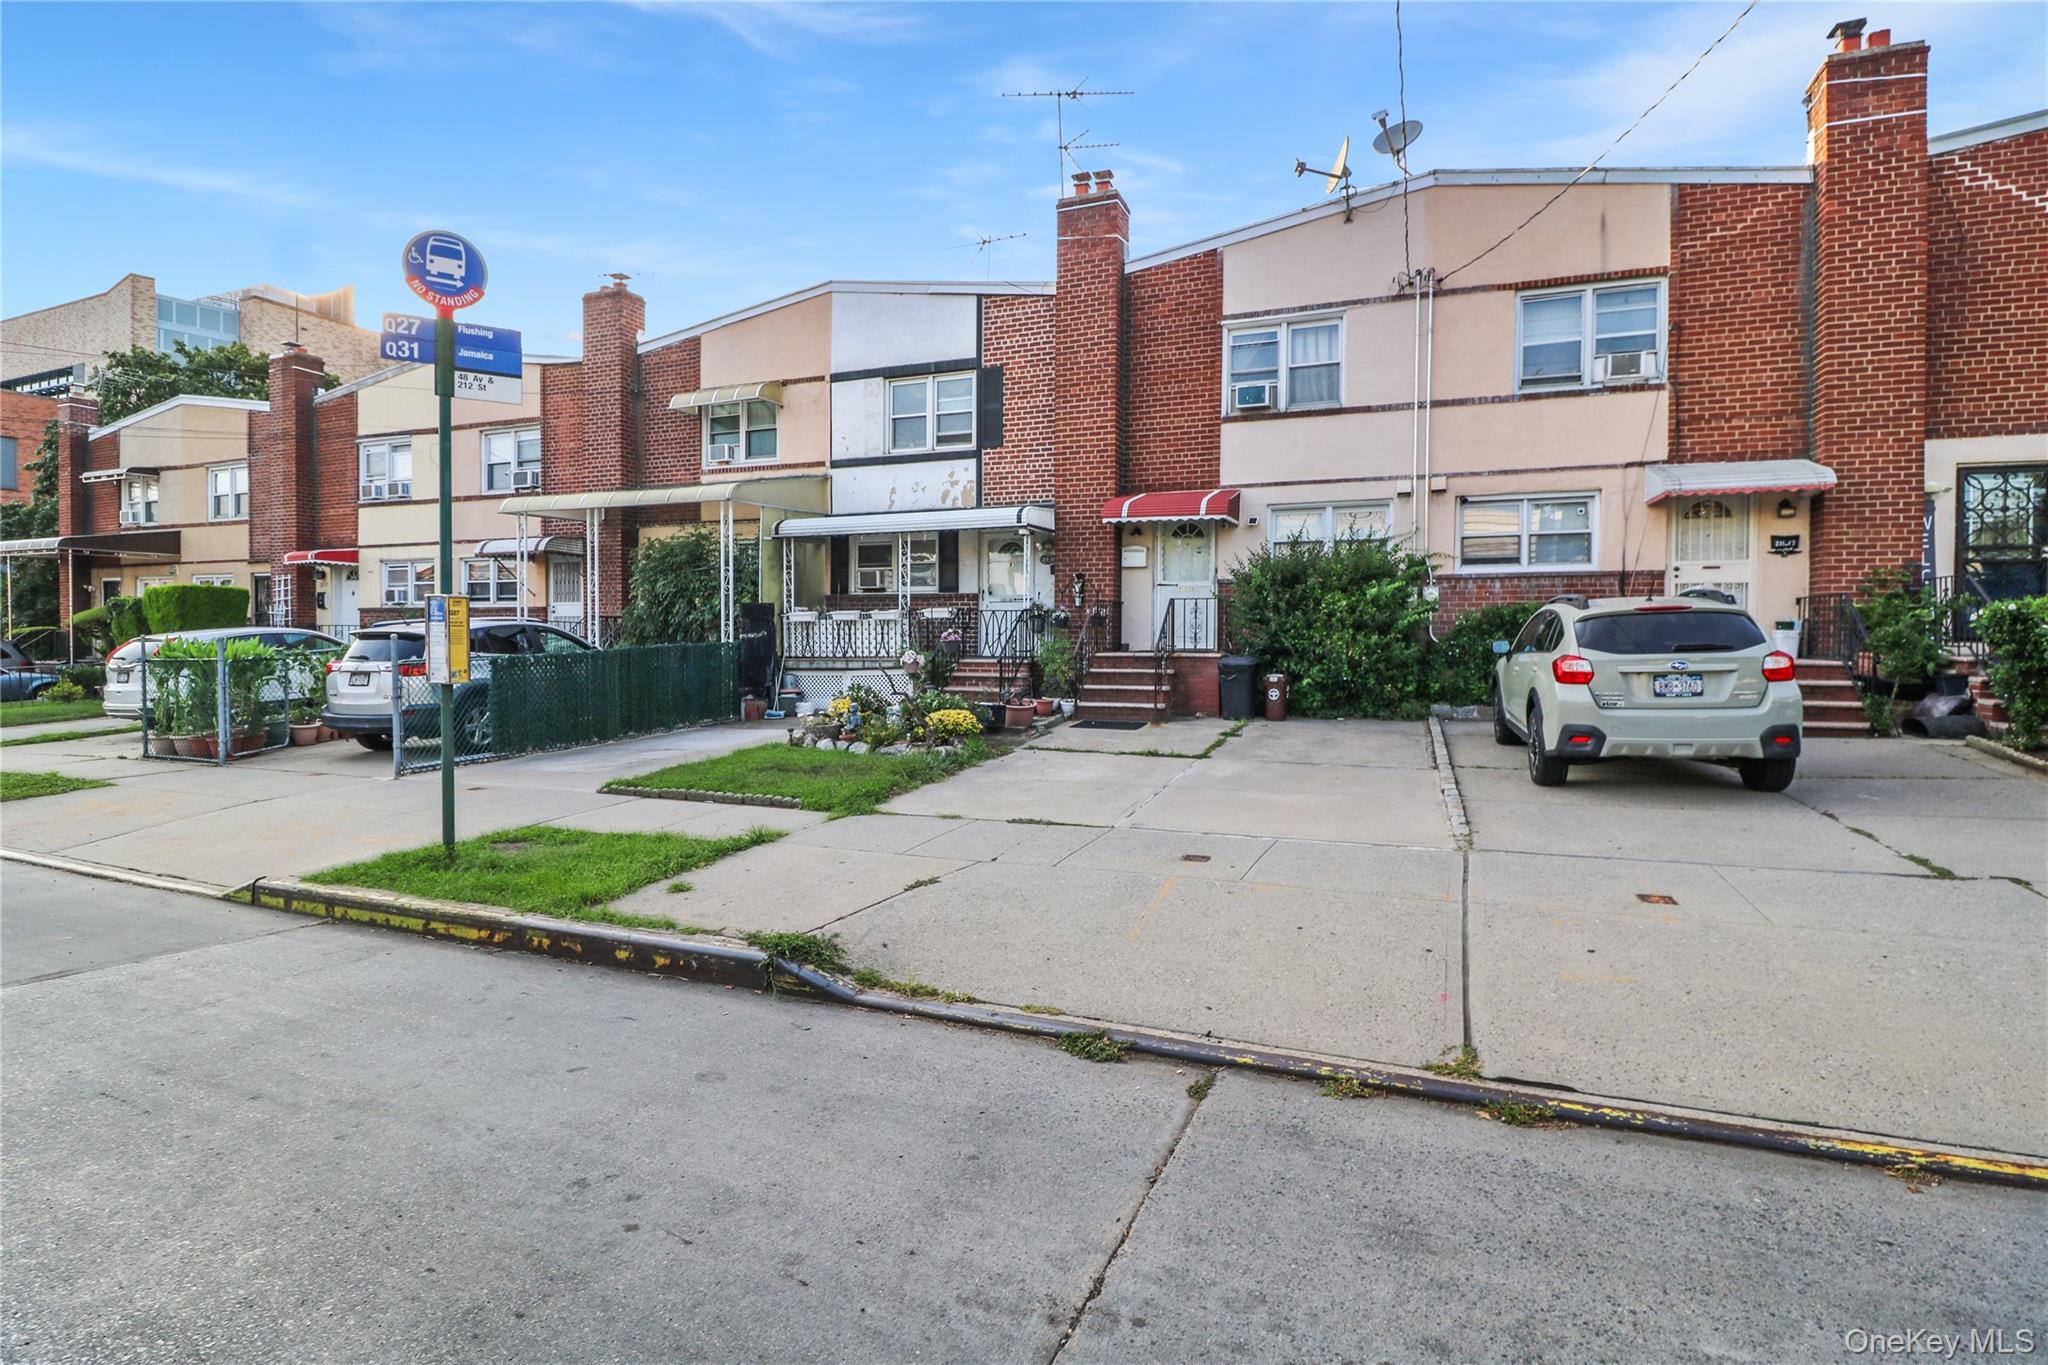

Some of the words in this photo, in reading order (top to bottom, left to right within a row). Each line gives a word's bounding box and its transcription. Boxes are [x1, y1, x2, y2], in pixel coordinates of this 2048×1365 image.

[410, 279, 426, 294] NO
[426, 289, 479, 307] STANDING
[384, 317, 421, 335] Q27
[457, 325, 494, 339] Flushing
[385, 340, 420, 359] Q31
[457, 348, 494, 361] Jamaica
[458, 373, 468, 381] 48
[473, 375, 483, 383] Av
[488, 376, 494, 384] &
[458, 382, 473, 390] 212
